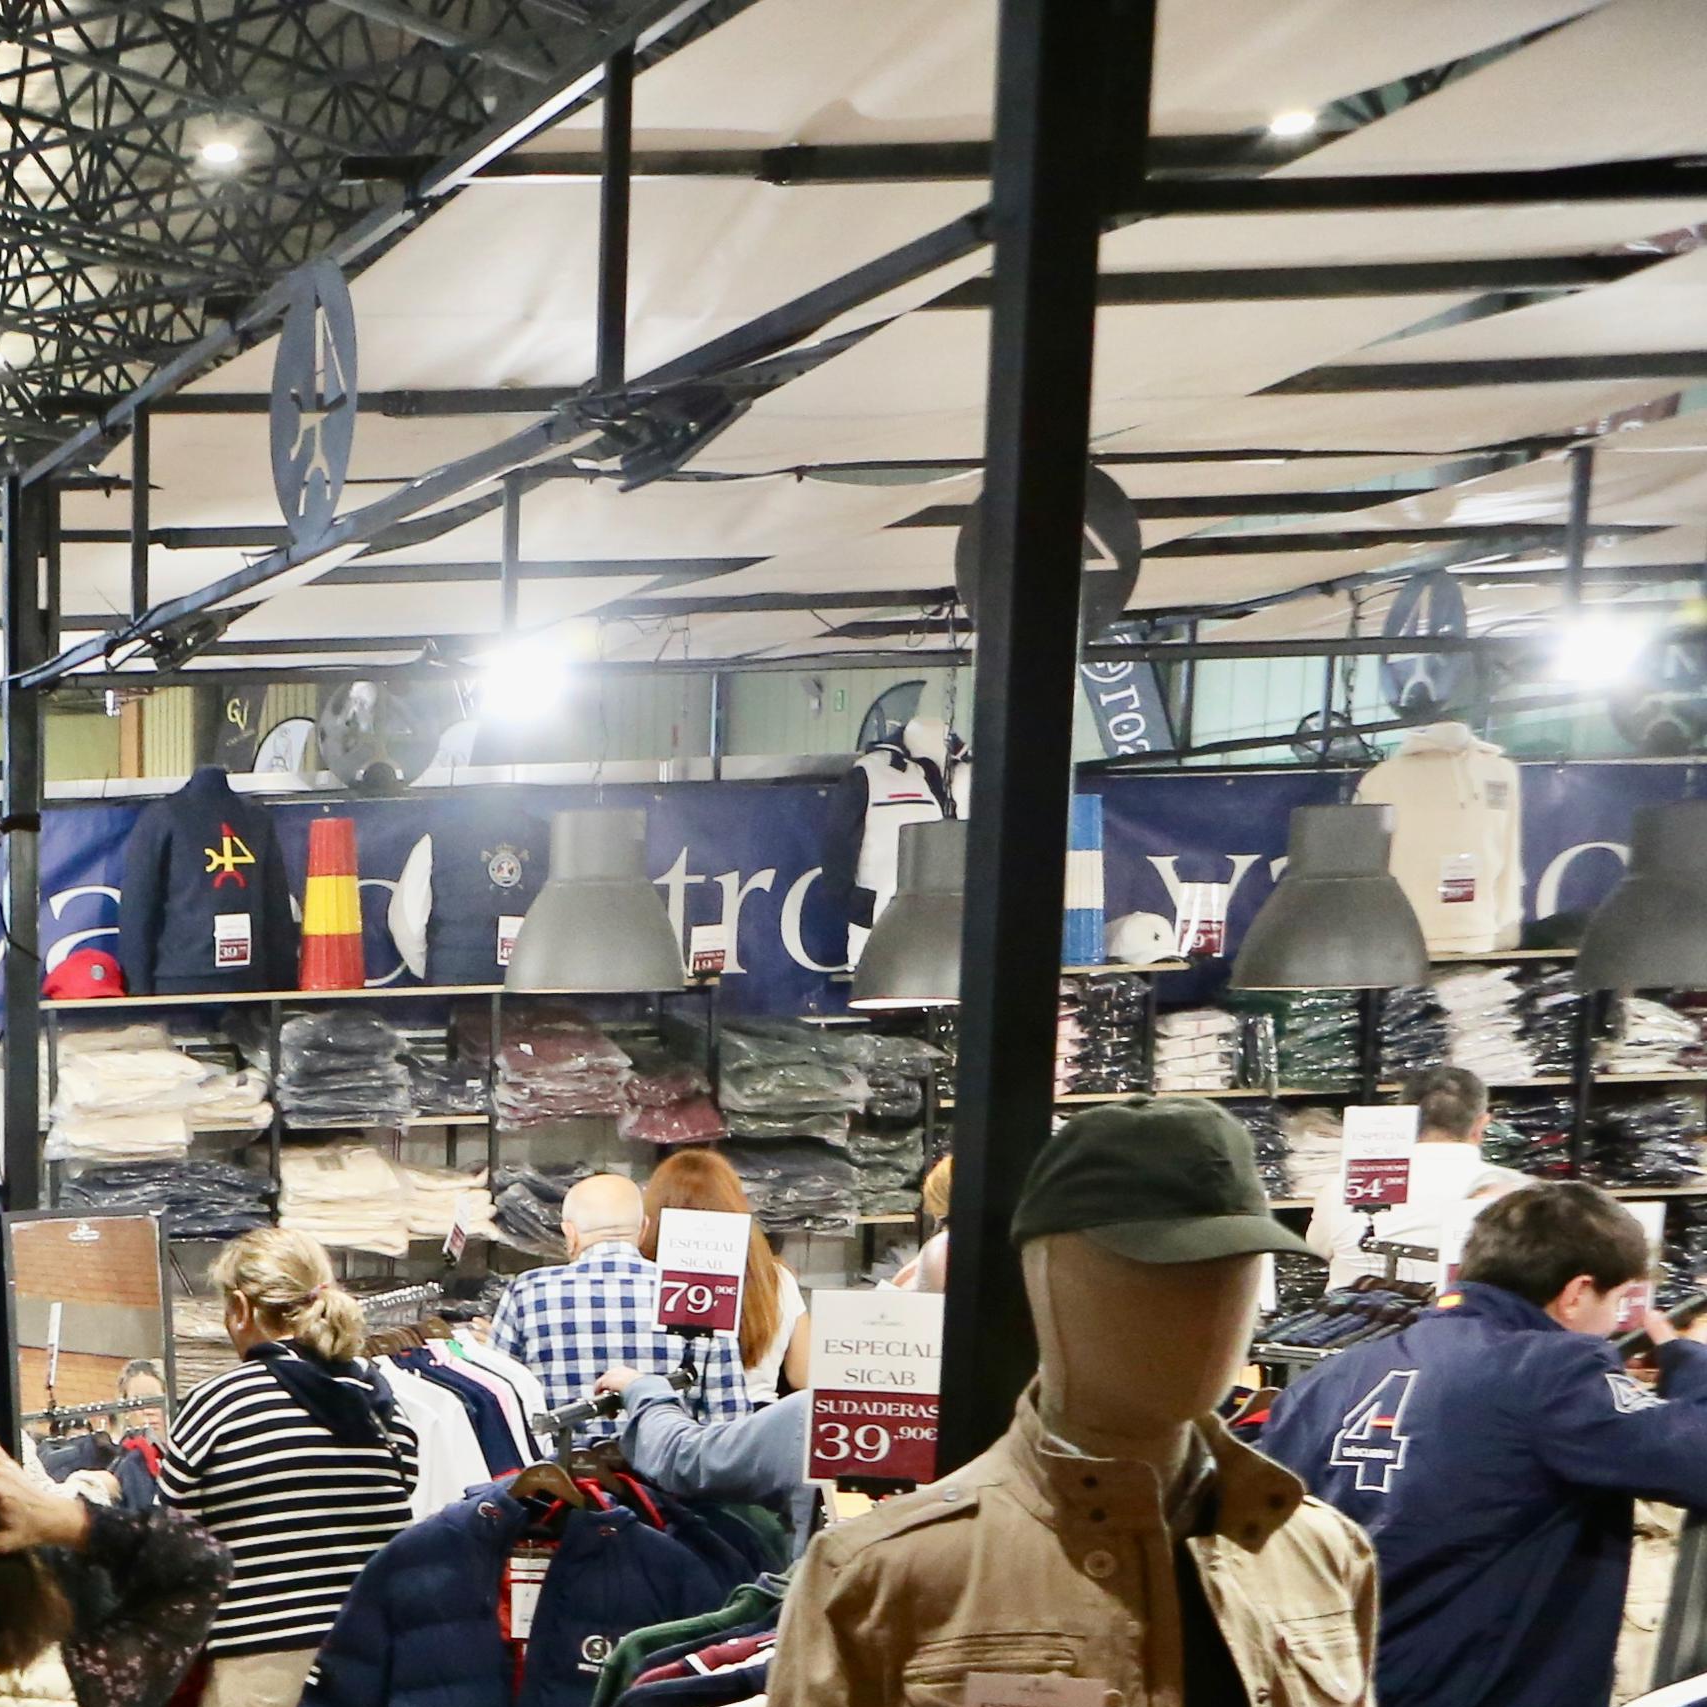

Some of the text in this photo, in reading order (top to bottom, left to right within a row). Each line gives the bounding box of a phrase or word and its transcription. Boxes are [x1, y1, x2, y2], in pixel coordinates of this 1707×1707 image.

[668, 1238, 736, 1253] ESPECIAL
[679, 1256, 724, 1270] SICAB
[824, 1339, 940, 1359] ESPECIAL
[843, 1368, 917, 1387] SICAB
[814, 1399, 939, 1419] SUDADERAS
[1329, 1369, 1419, 1493] 4
